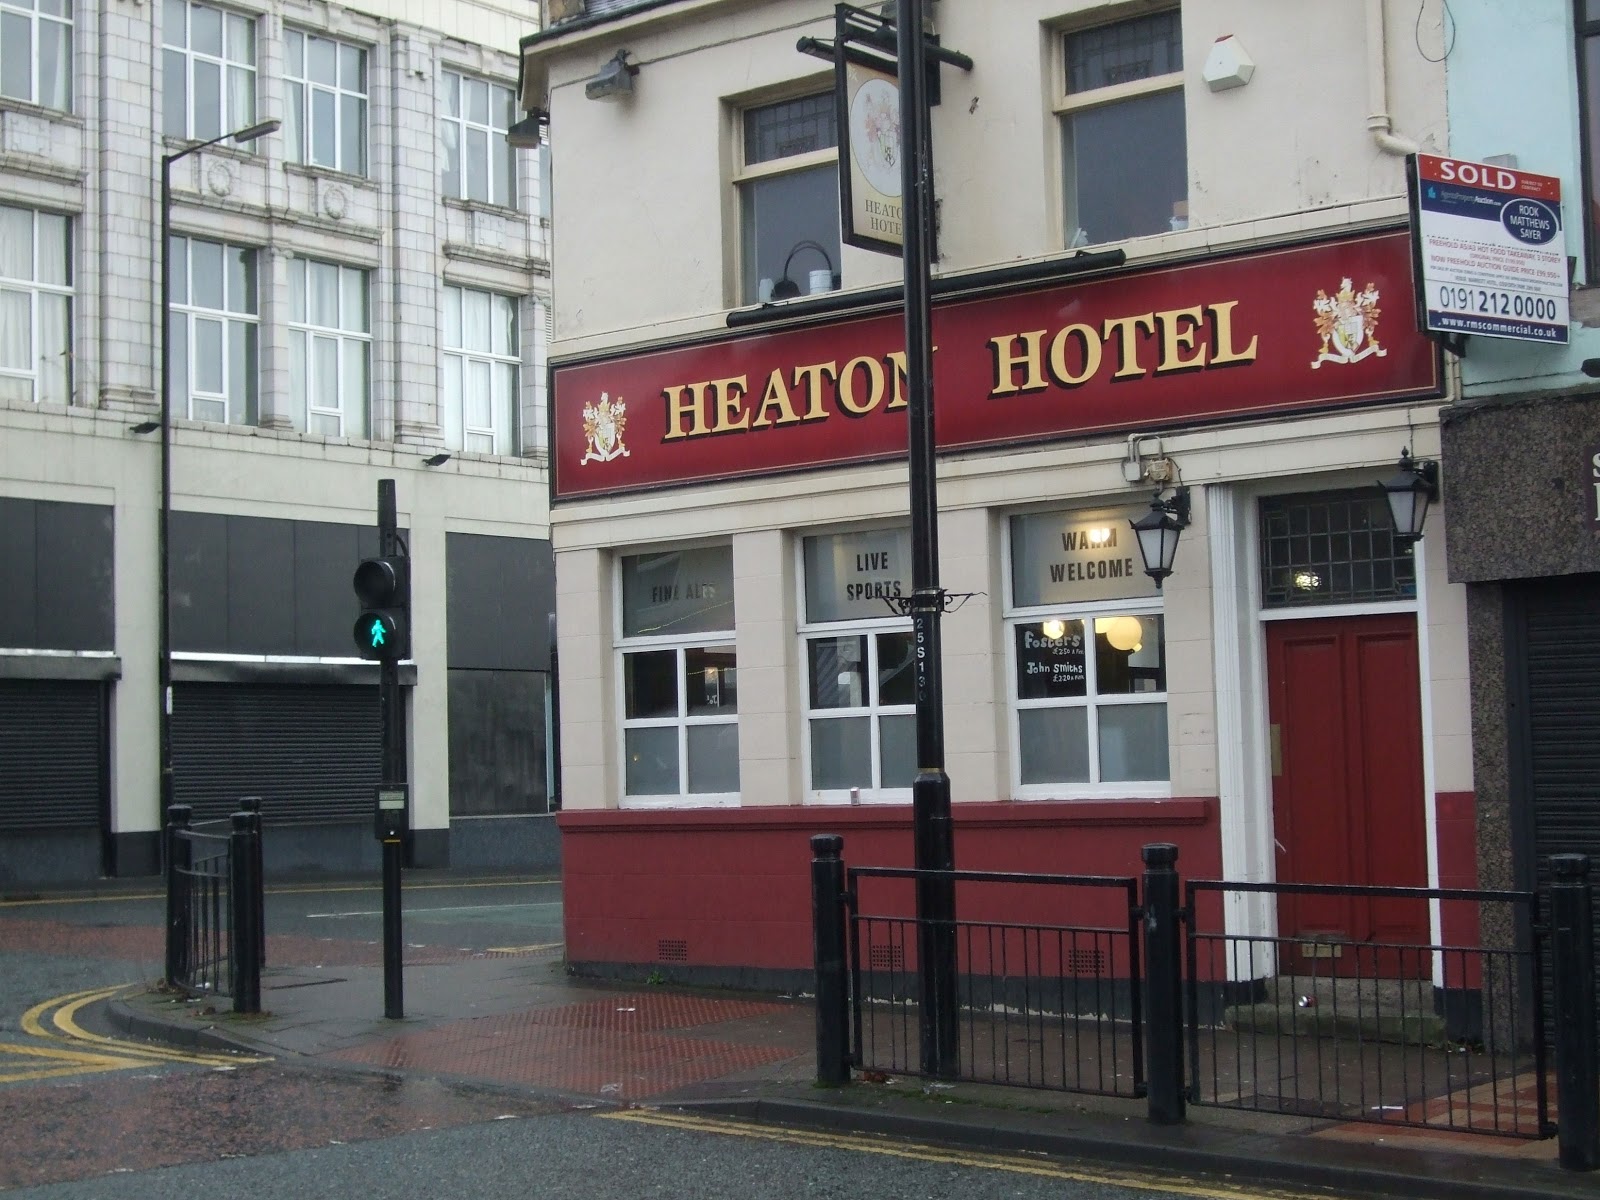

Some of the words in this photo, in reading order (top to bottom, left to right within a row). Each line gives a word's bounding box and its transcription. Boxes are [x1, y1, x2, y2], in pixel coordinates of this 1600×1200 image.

[1440, 161, 1517, 190] SOLD
[865, 199, 902, 221] HEATO
[1519, 205, 1539, 217] ROOK
[870, 216, 902, 236] HOTE
[1510, 215, 1550, 230] MATTHEWS
[1520, 228, 1542, 240] SAYER
[1476, 260, 1501, 270] AUCTION
[1502, 264, 1519, 273] GUIDE
[1440, 286, 1475, 310] 0191
[1479, 290, 1510, 315] 212
[1514, 295, 1556, 320] 0000
[1442, 317, 1557, 338] www.rmscommercial.co.uk
[990, 299, 1258, 396] HOTEL
[856, 552, 888, 572] LIVE
[1050, 558, 1133, 583] WELCOME
[846, 581, 901, 601] SPORTS
[1026, 661, 1051, 675] John
